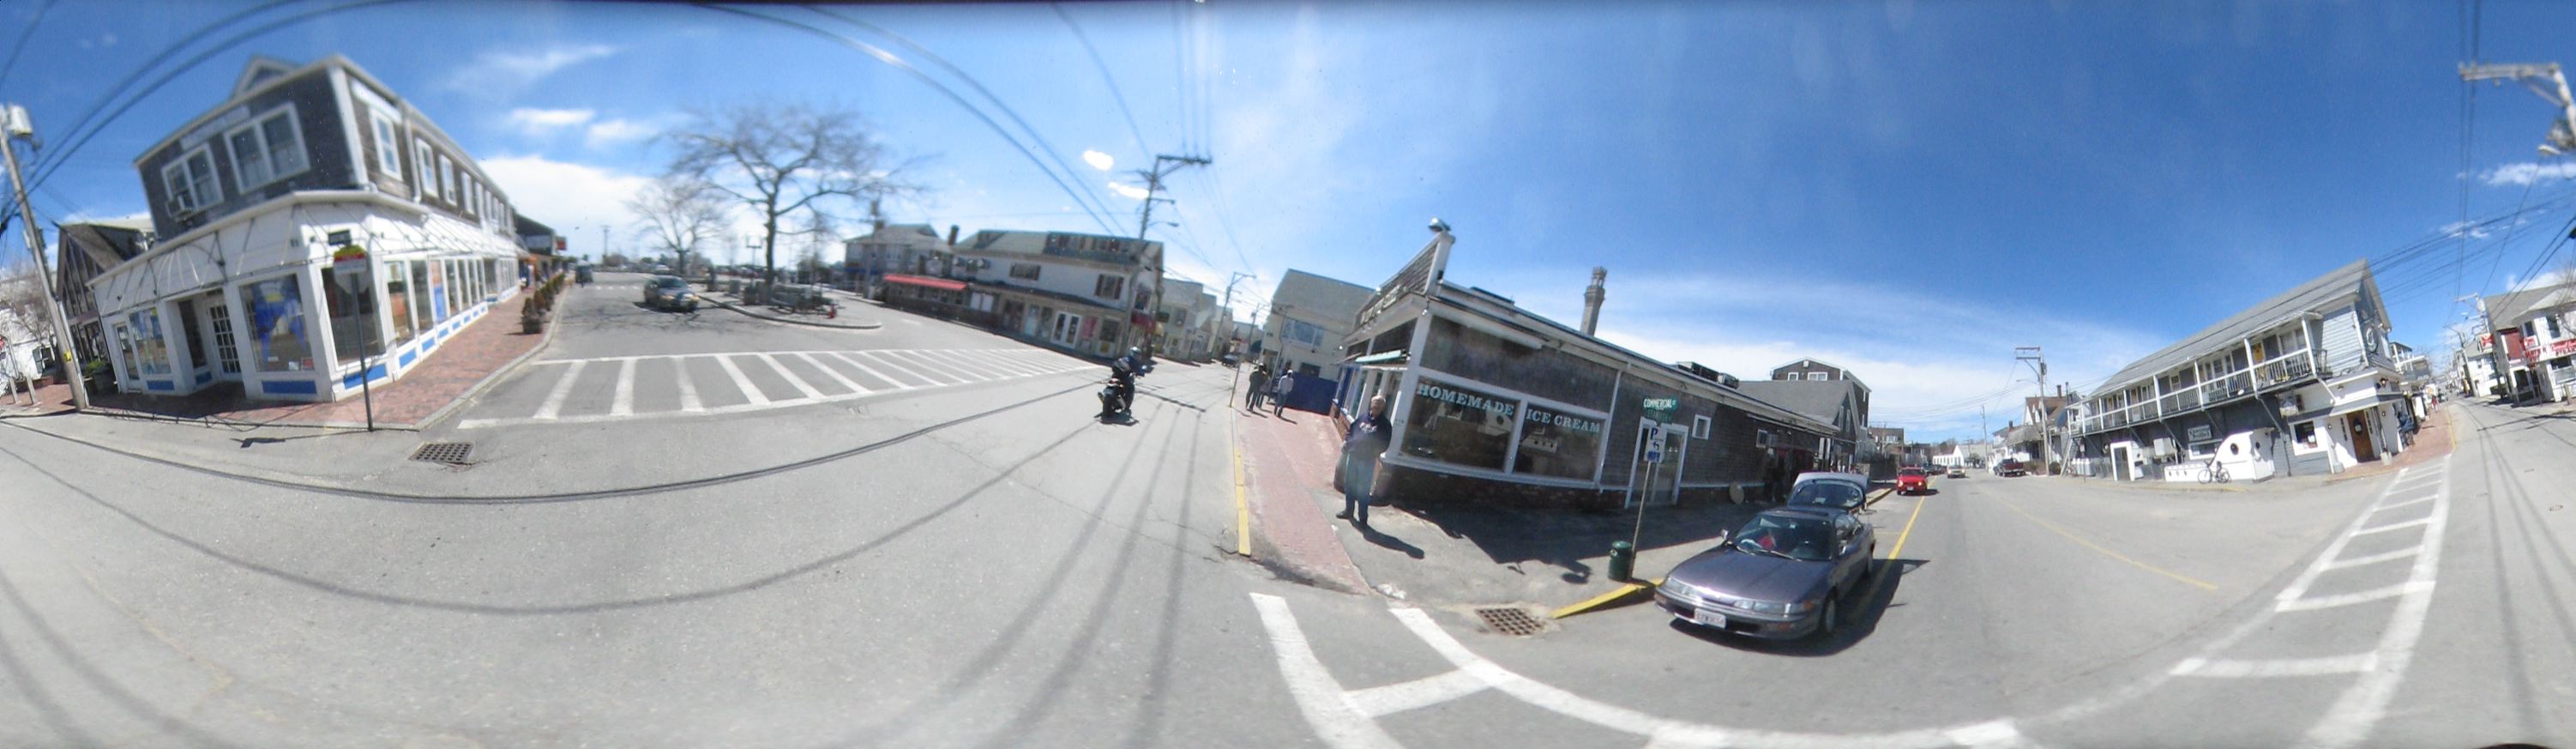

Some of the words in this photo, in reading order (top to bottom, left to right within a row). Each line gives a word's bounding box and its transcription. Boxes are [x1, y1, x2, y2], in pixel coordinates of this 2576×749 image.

[1417, 383, 1515, 416] HOMEMADE
[1526, 408, 1551, 425] ICE
[1554, 414, 1601, 433] CREAM
